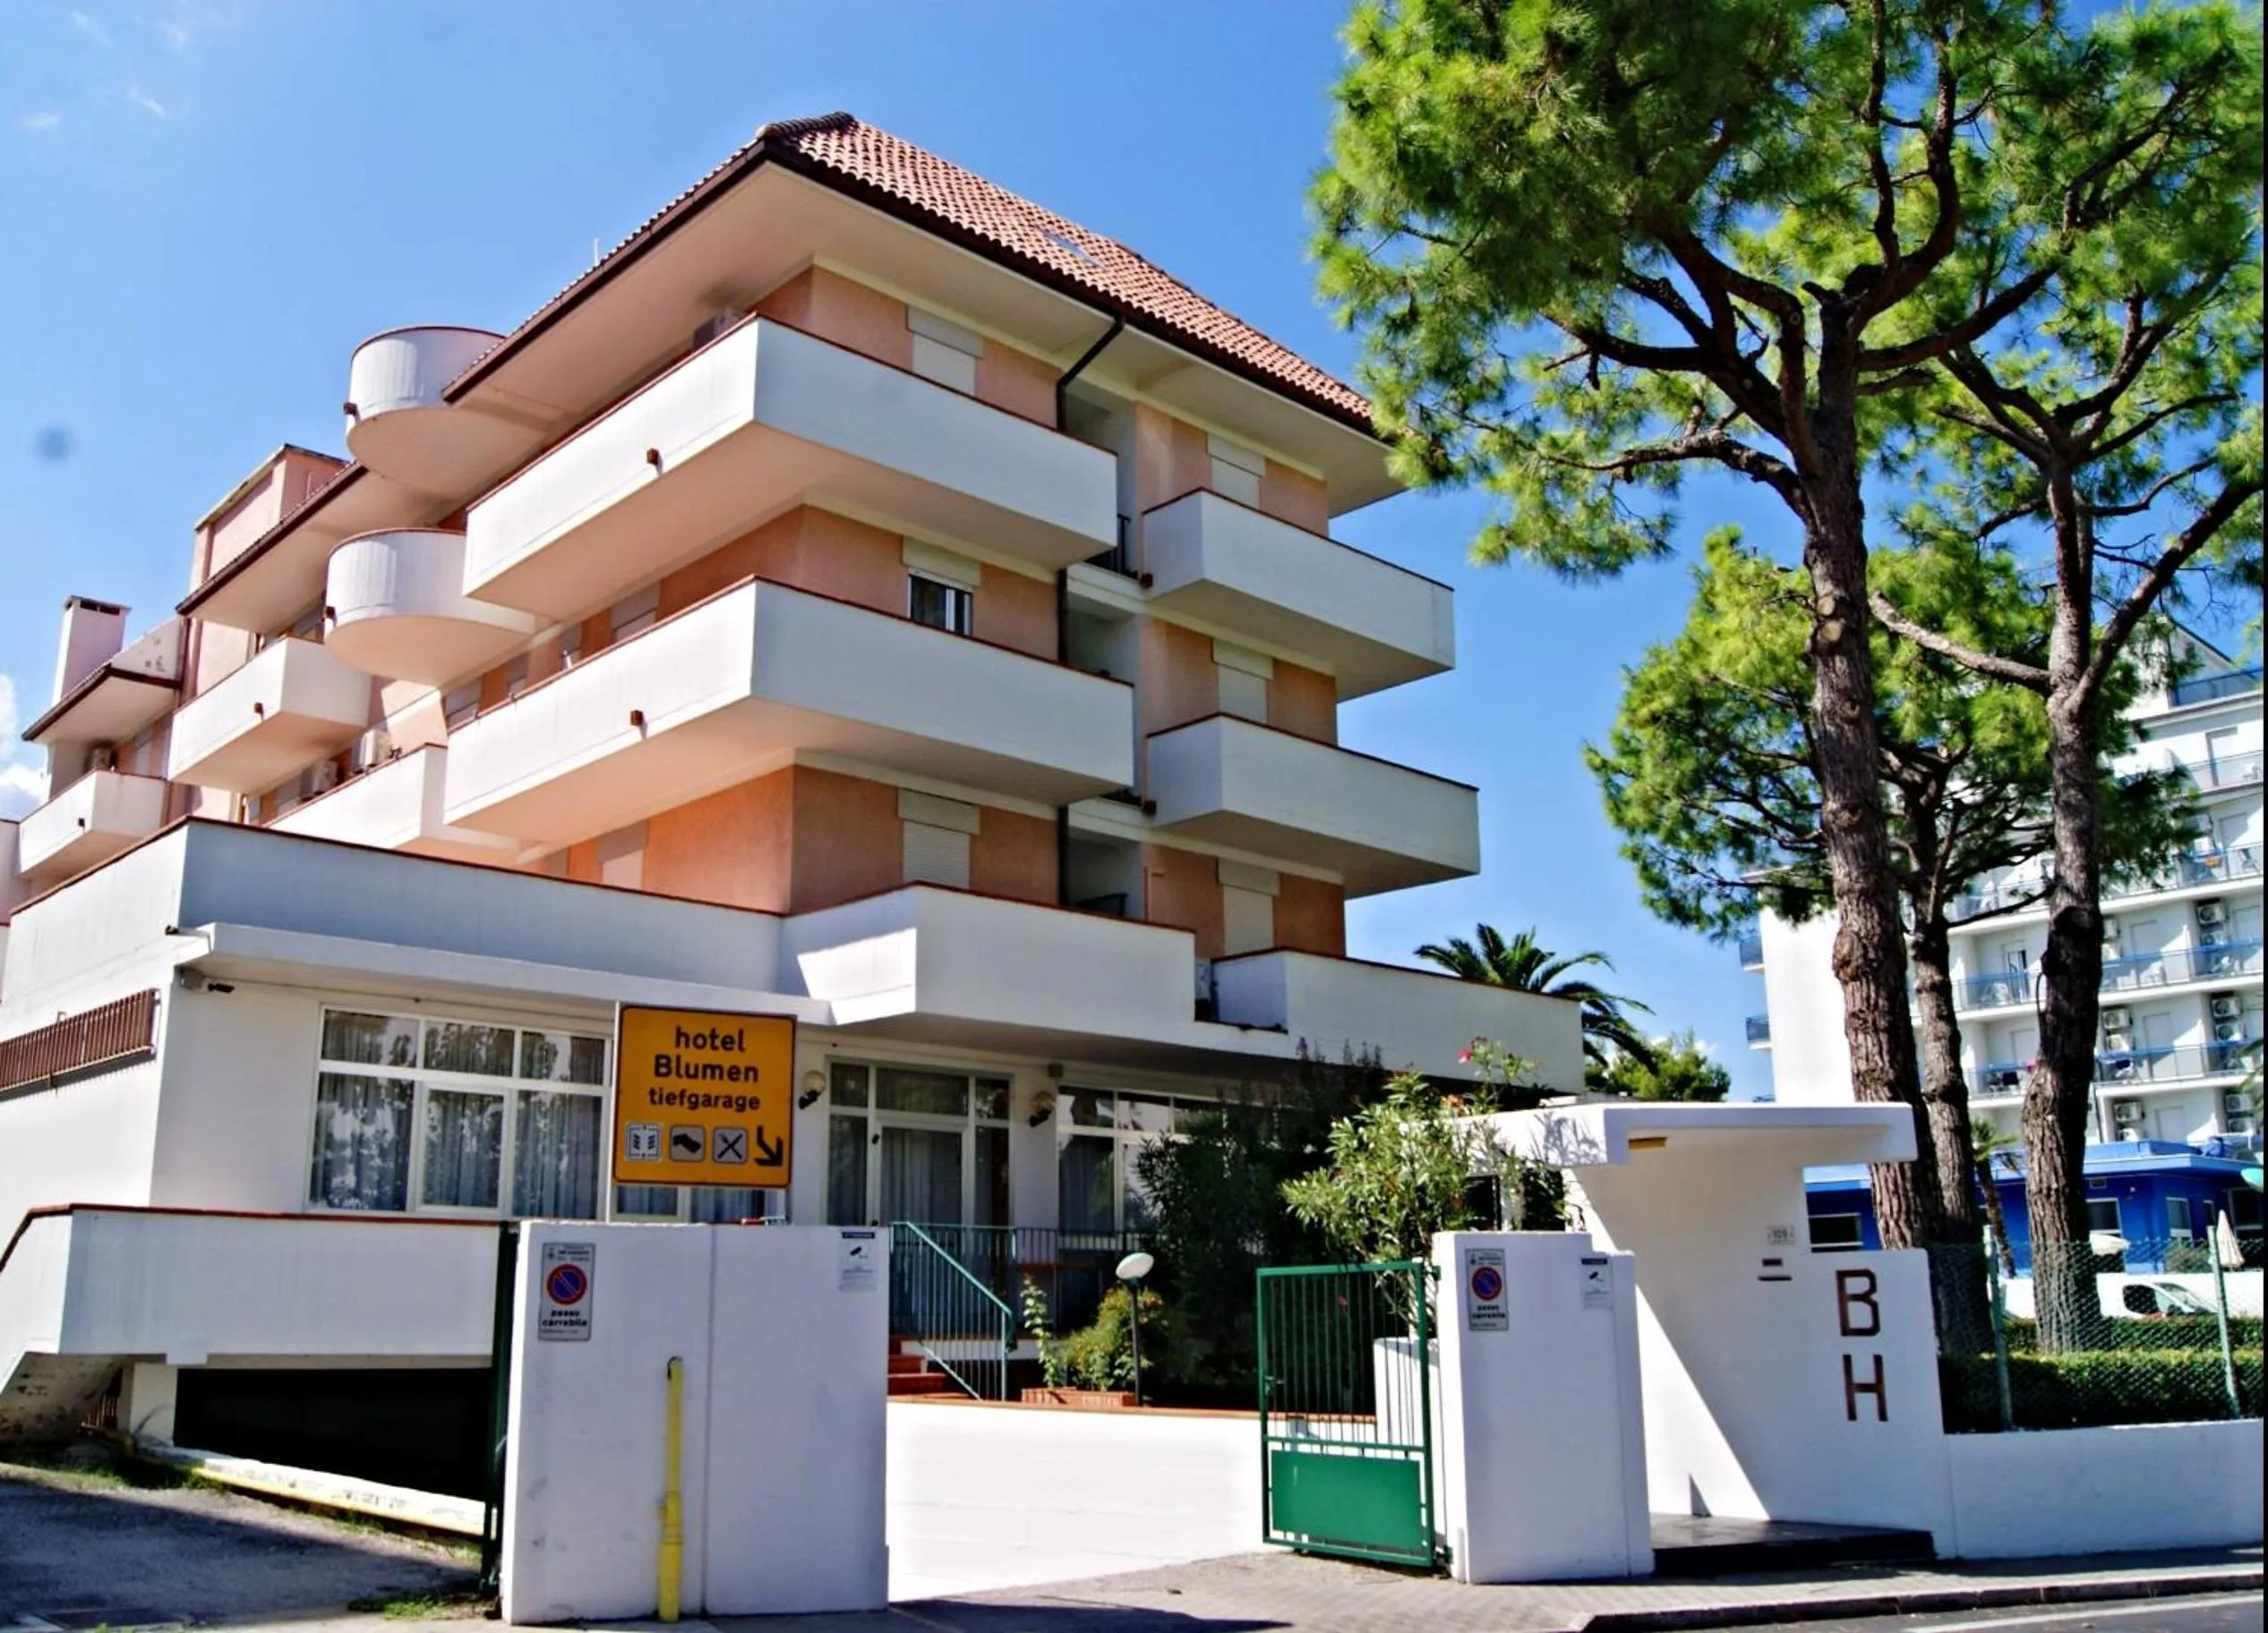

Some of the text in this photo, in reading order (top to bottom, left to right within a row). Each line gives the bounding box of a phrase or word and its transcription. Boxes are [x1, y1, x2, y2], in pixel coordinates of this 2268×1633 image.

[674, 1025, 746, 1053] hotel
[654, 1054, 758, 1082] Blumen
[647, 1088, 760, 1113] tiefgarage
[1836, 1269, 1881, 1337] B
[1842, 1354, 1888, 1422] H
